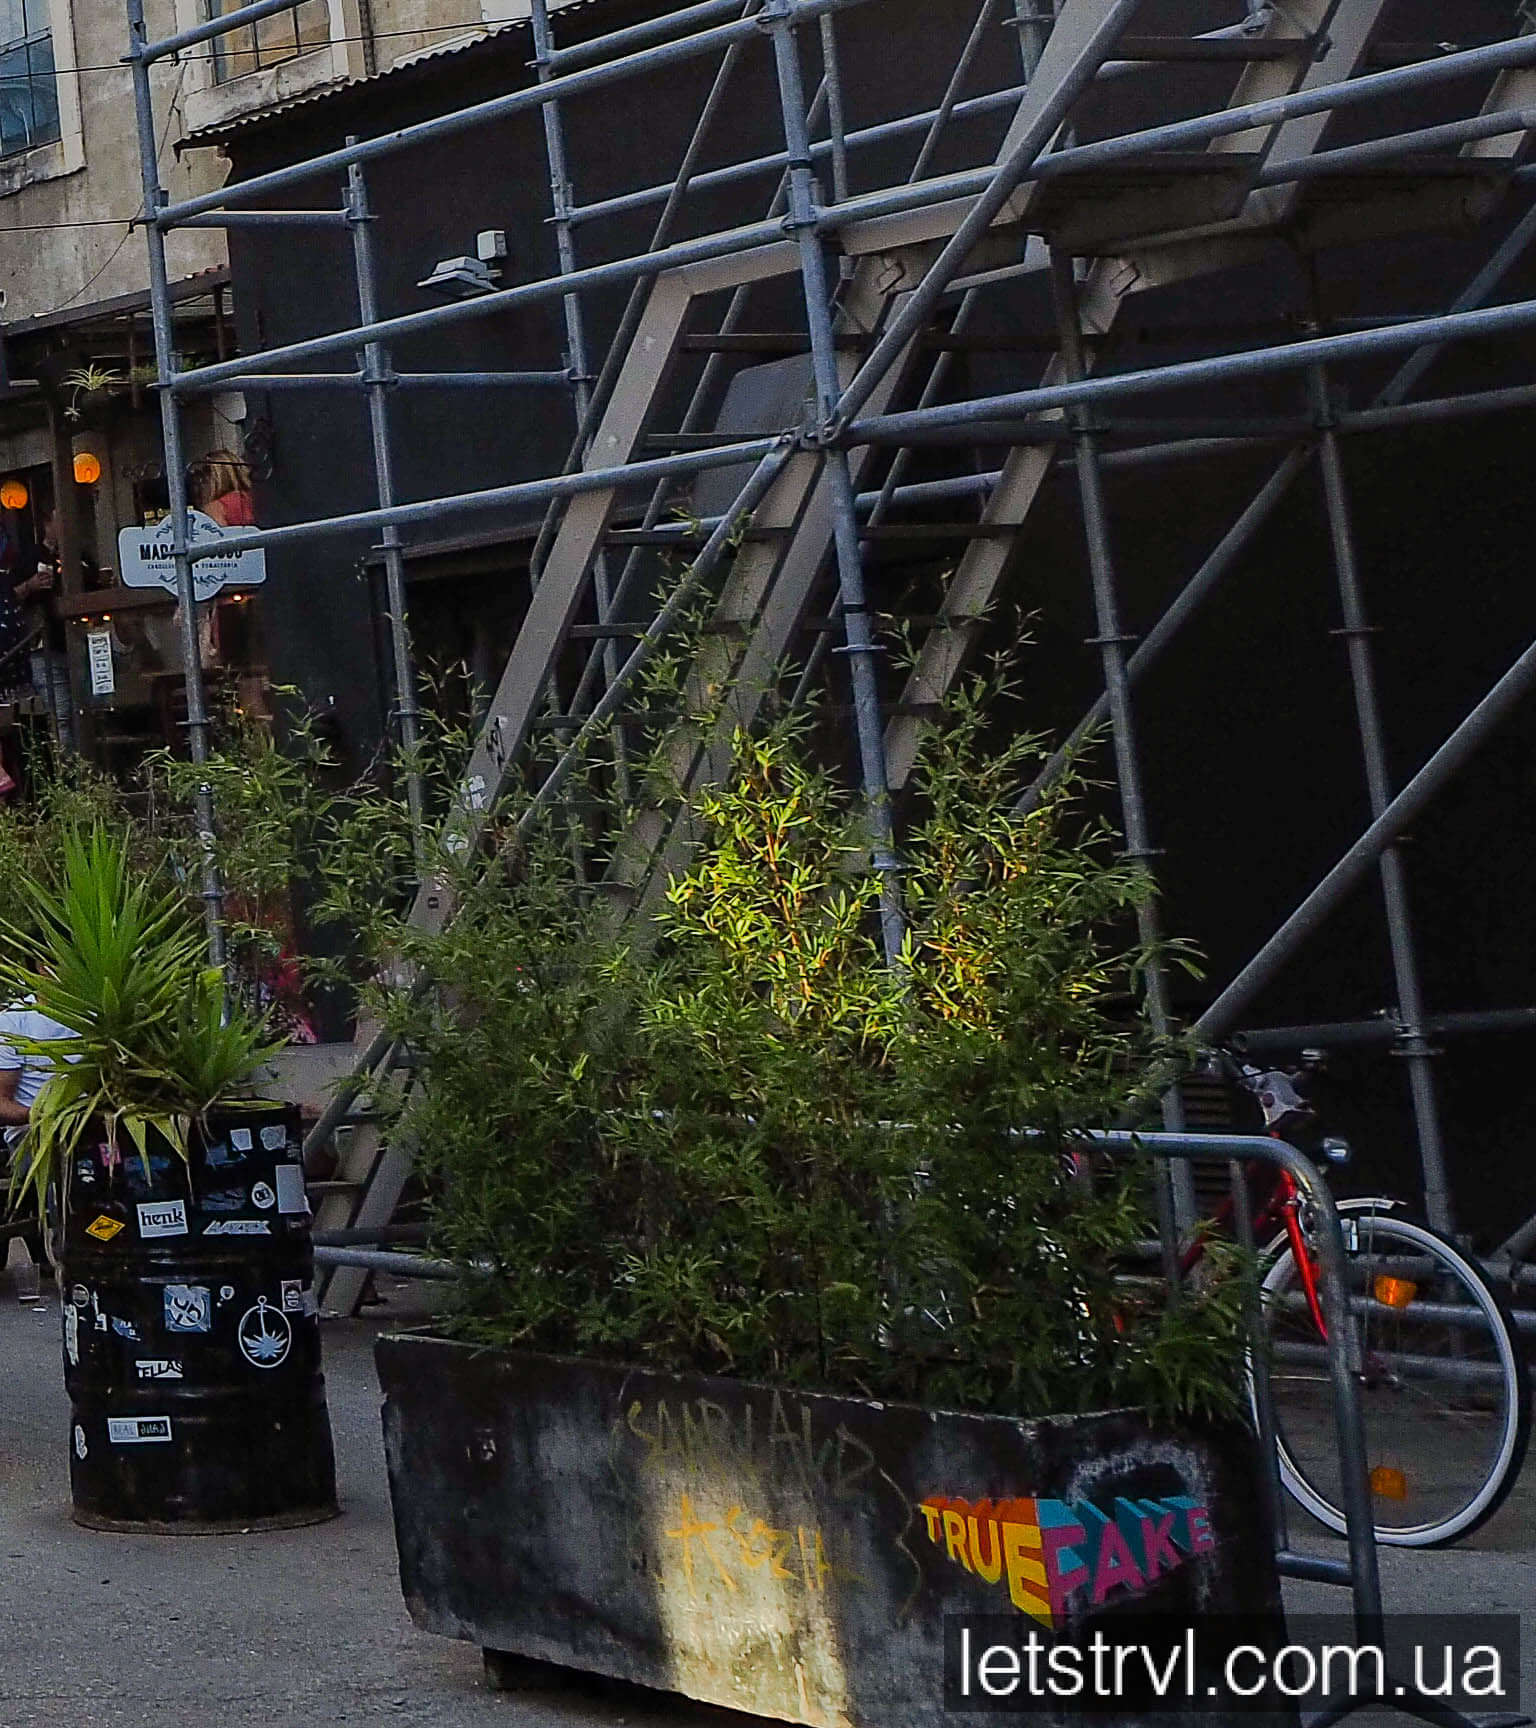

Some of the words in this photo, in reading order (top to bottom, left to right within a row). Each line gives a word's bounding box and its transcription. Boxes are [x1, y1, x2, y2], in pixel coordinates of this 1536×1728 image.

[139, 1206, 185, 1227] henk
[917, 1496, 1054, 1631] TRUE
[1038, 1498, 1215, 1630] FAKE
